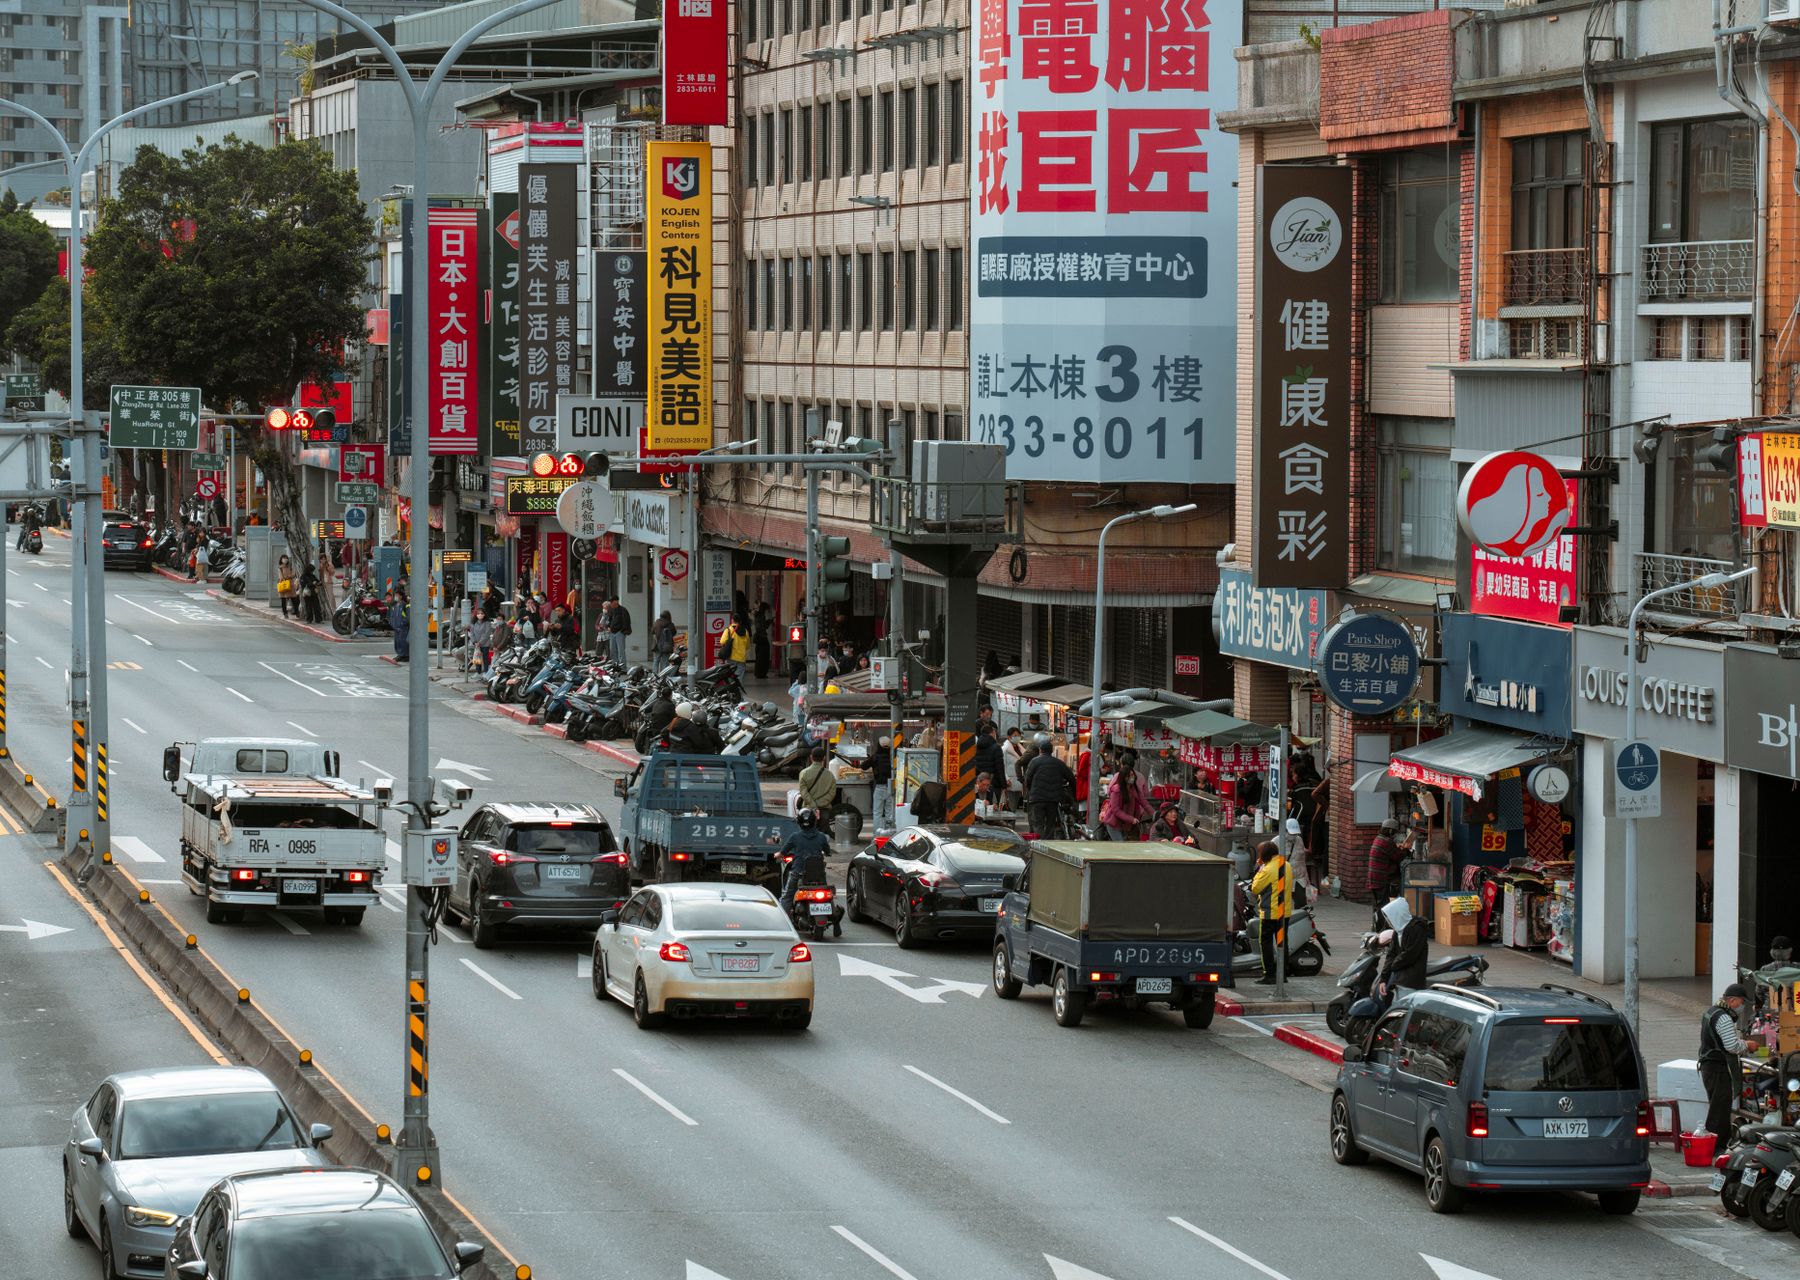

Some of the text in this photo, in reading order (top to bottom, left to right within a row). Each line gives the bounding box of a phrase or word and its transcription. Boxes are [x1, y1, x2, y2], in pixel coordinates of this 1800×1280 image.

[979, 107, 1210, 215] 找巨匠
[661, 208, 700, 216] KOJEN
[661, 220, 700, 229] English
[661, 231, 700, 239] Centers
[1276, 219, 1328, 252] Jian
[981, 252, 1195, 282] 國際原廠授權教育中心
[555, 259, 570, 305] 減重
[659, 245, 702, 426] 科見美語
[978, 413, 1204, 461] 2833-8011
[1277, 299, 1330, 561] 健康食彩
[551, 541, 563, 582] DAISO
[1347, 632, 1402, 648] Paris Shop
[1178, 660, 1197, 673] 288
[1338, 678, 1399, 695] 生活百貨
[1579, 664, 1713, 723] LOUIS COFFEE
[249, 839, 270, 853] RFA
[288, 839, 317, 854] 0995
[1482, 835, 1506, 850] 89
[1113, 948, 1206, 964] APD 2695
[1137, 980, 1171, 992] APD-2695
[1545, 1122, 1588, 1135] AXK-1972
